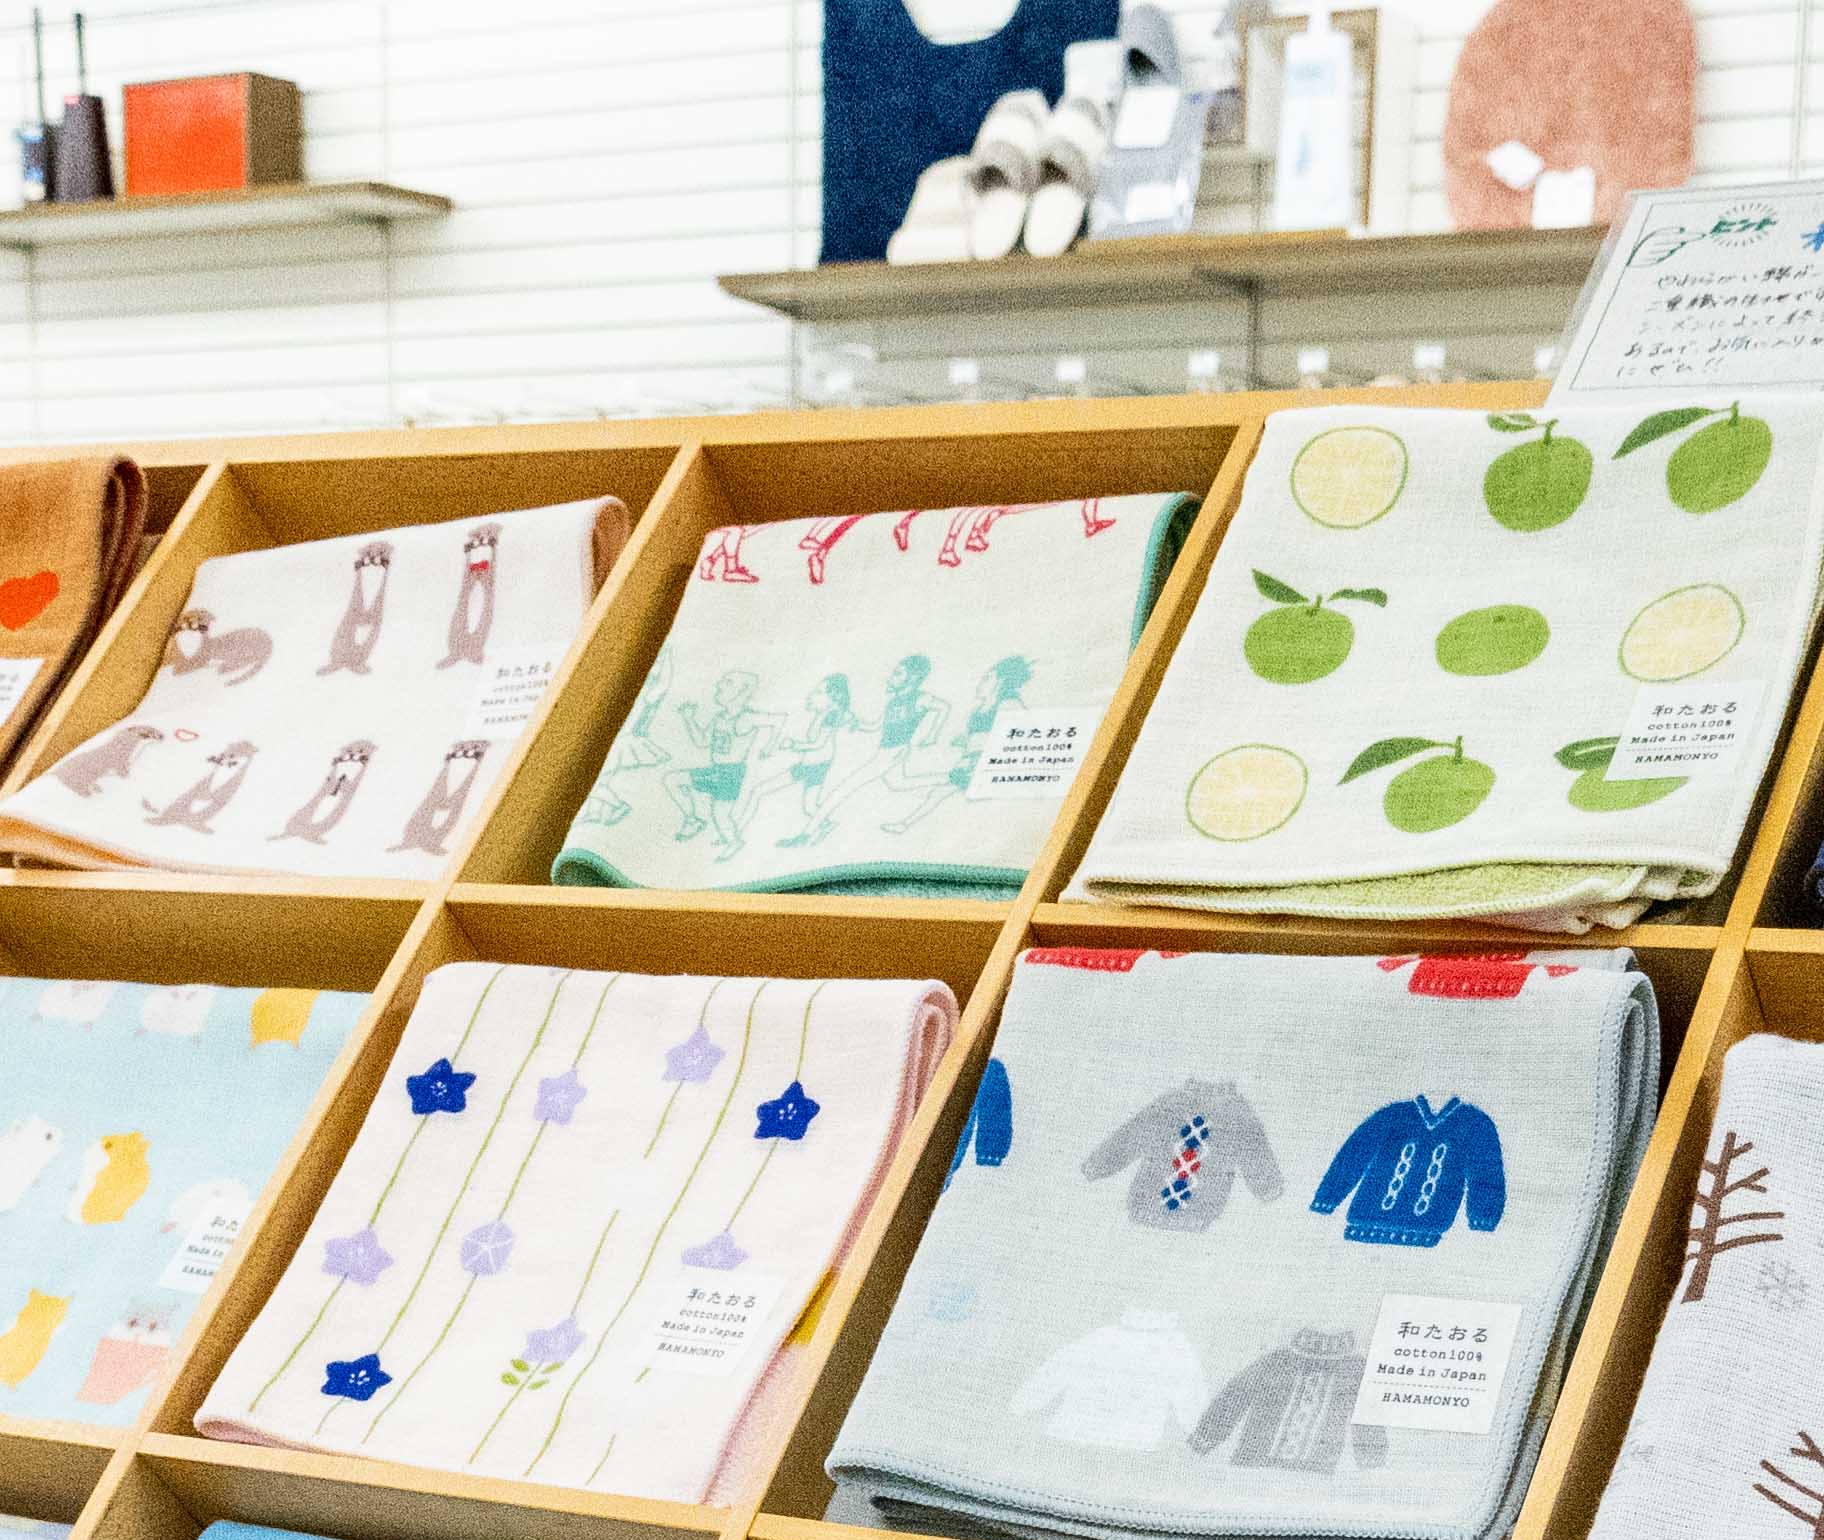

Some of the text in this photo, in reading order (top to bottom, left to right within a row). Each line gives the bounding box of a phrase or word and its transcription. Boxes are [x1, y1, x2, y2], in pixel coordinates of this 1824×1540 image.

[1397, 1321, 1488, 1343] 和たおる
[1394, 1348, 1483, 1361] cotton100%
[1378, 1363, 1486, 1381] Made in Japan
[1382, 1392, 1469, 1407] HAMAMONYO
